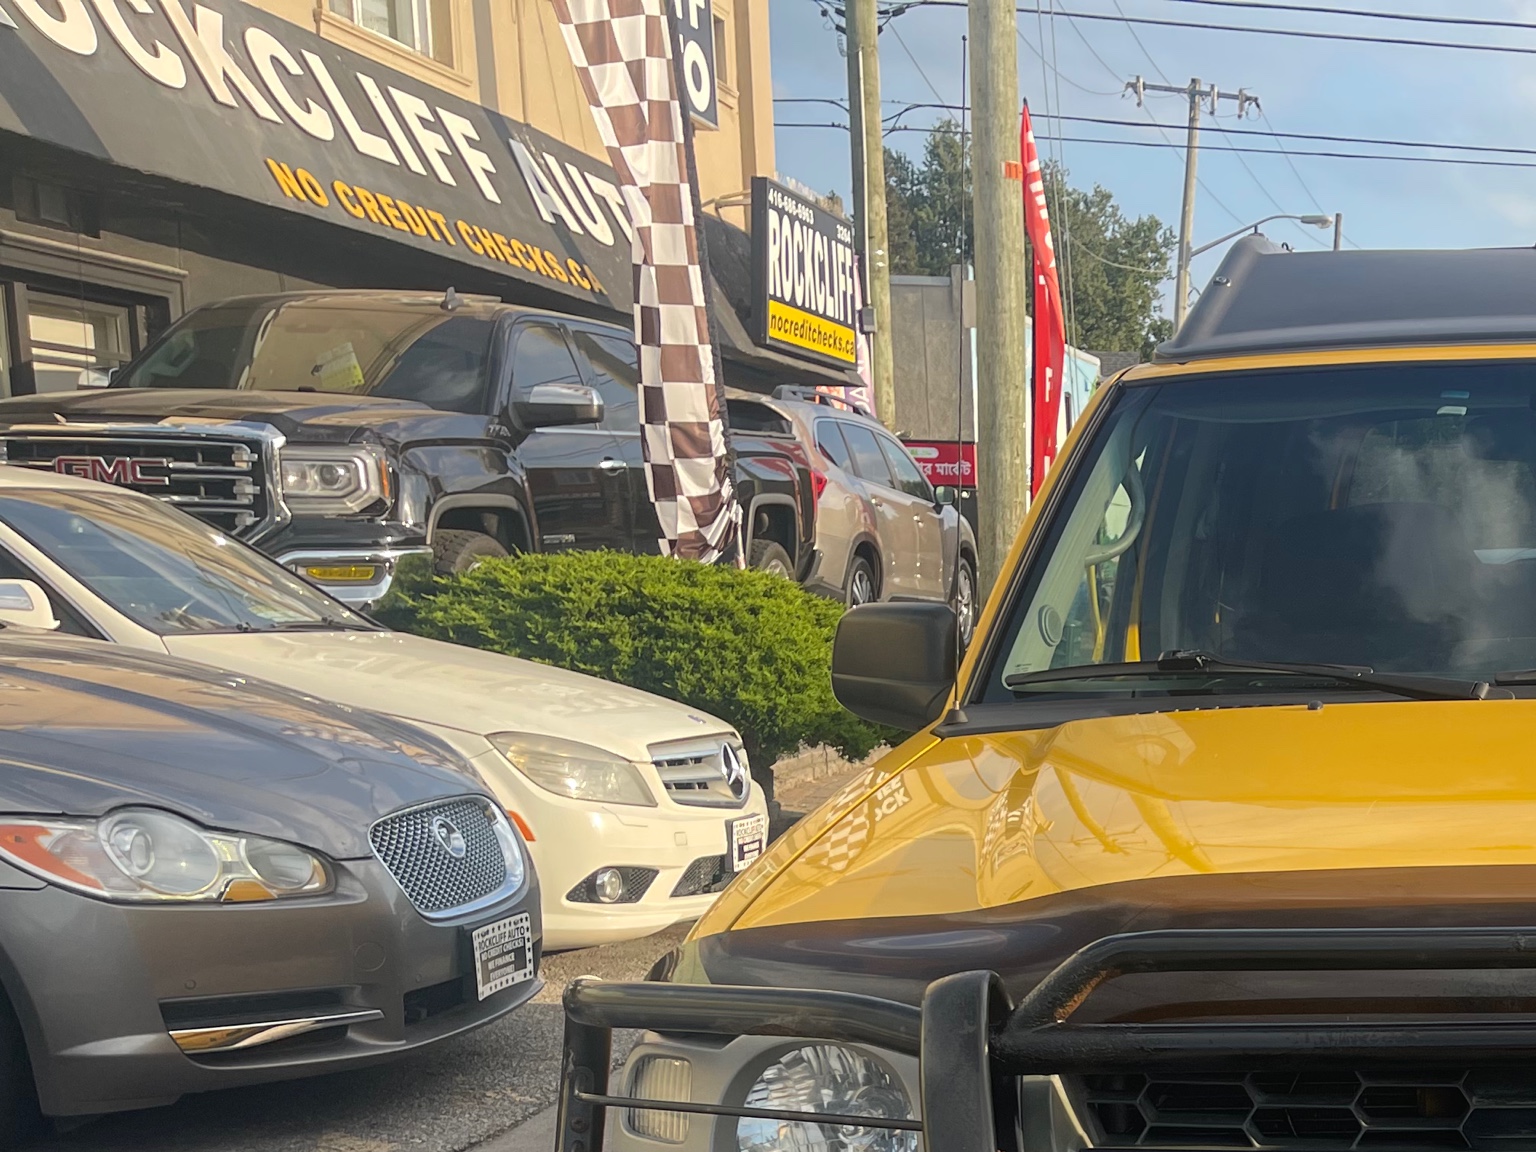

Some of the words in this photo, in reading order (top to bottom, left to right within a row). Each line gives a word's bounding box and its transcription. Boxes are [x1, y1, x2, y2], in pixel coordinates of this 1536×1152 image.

[0, 0, 500, 204] OCKCLIFF
[509, 138, 633, 247] AUT
[265, 157, 329, 207] NO
[331, 180, 457, 246] CREDIT
[455, 219, 608, 295] CHECKS.CA
[768, 208, 854, 325] ROCKCLIFF
[770, 312, 855, 356] nocreditchecks.ca
[55, 456, 169, 486] GMC
[508, 925, 525, 939] AUTO
